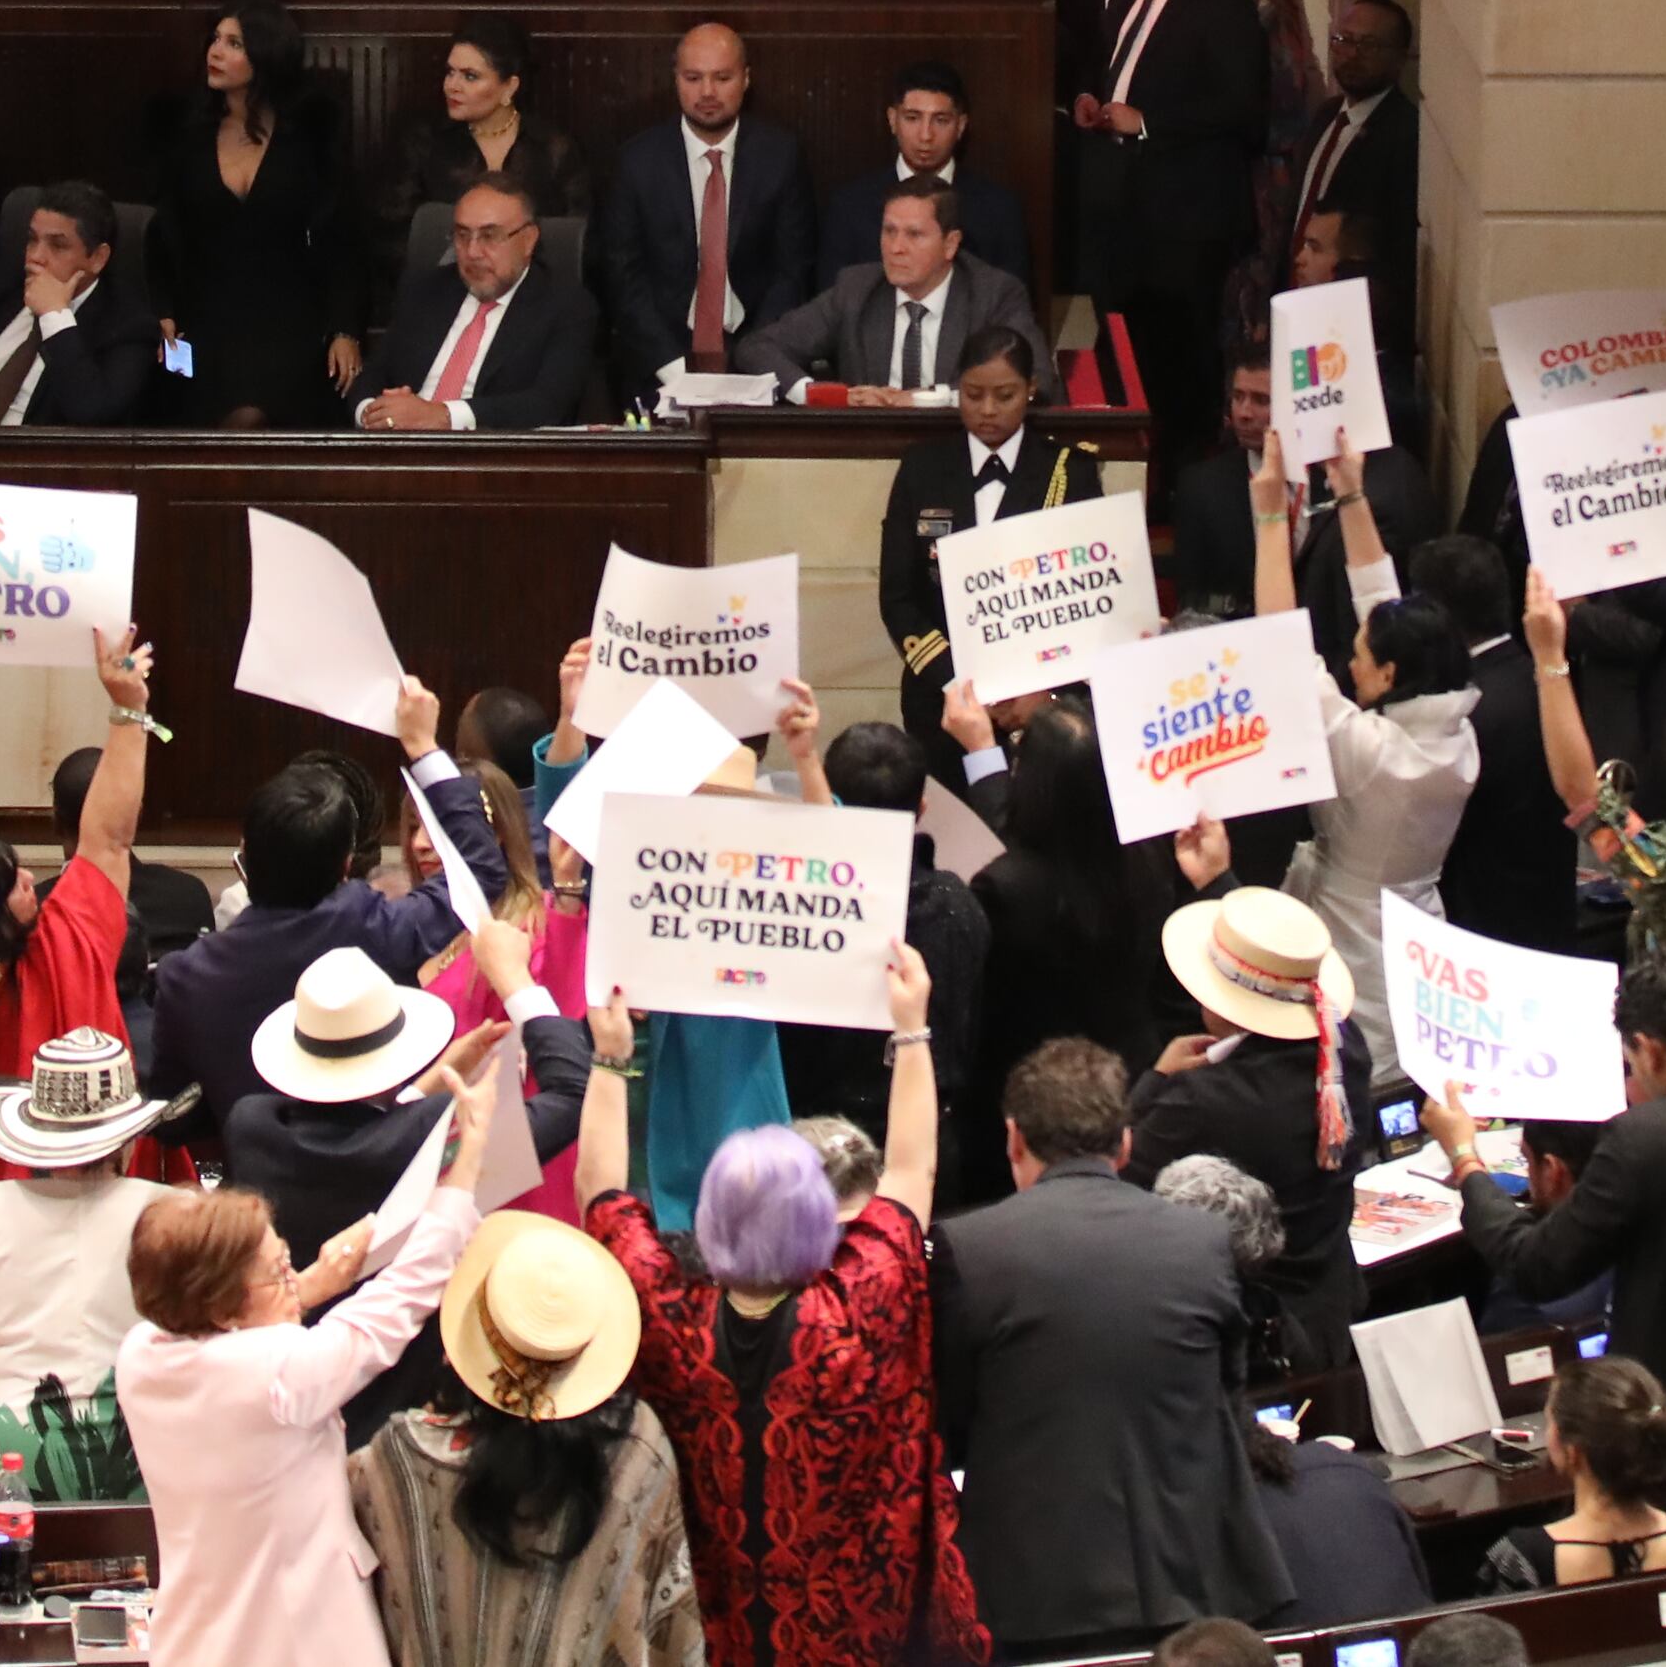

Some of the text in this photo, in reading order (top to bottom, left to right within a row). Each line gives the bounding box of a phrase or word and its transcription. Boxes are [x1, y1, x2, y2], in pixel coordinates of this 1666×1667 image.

[1552, 497, 1572, 528] el
[964, 541, 1117, 594] CON PETRO,
[966, 567, 1123, 626] AQUÍ MANDA
[603, 610, 771, 650] Reelegiremos
[981, 596, 1114, 644] EL PUEBLO
[597, 640, 758, 677] el Cambio
[1142, 687, 1254, 749] siente
[636, 847, 865, 891] CON PETRO,
[630, 879, 865, 923] AQUÍ MANDA
[649, 914, 846, 953] EL PUEBLO
[1406, 940, 1489, 1003] VAS
